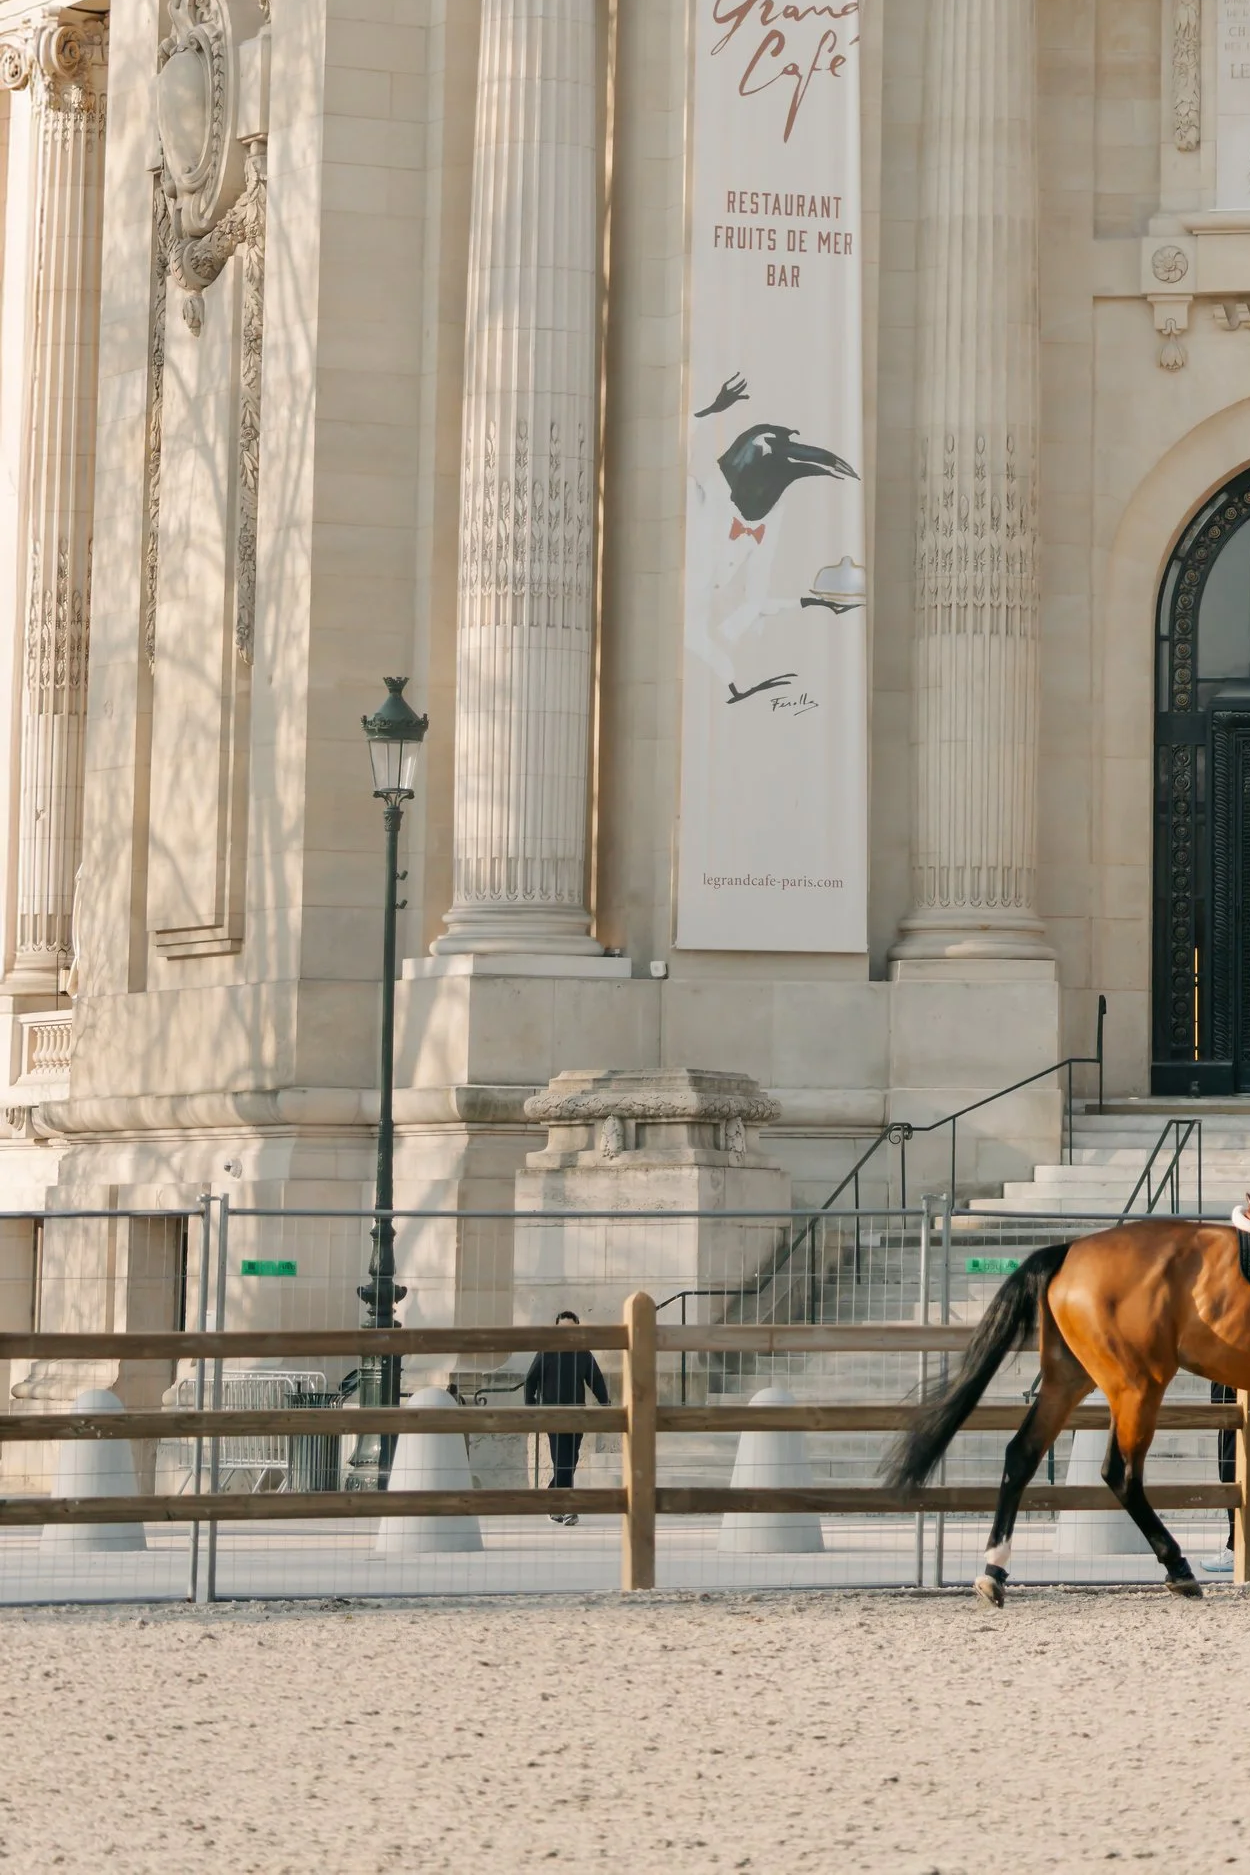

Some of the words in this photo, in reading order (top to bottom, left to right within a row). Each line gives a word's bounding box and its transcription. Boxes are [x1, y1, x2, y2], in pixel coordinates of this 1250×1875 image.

[1230, 63, 1250, 79] LE
[738, 29, 861, 144] Café
[727, 190, 842, 219] RESTAURANT
[714, 225, 777, 251] FRUITS
[787, 229, 808, 252] DE
[817, 231, 853, 255] MER
[766, 264, 800, 288] BAR
[702, 872, 844, 891] legrandcafe-paris.com
